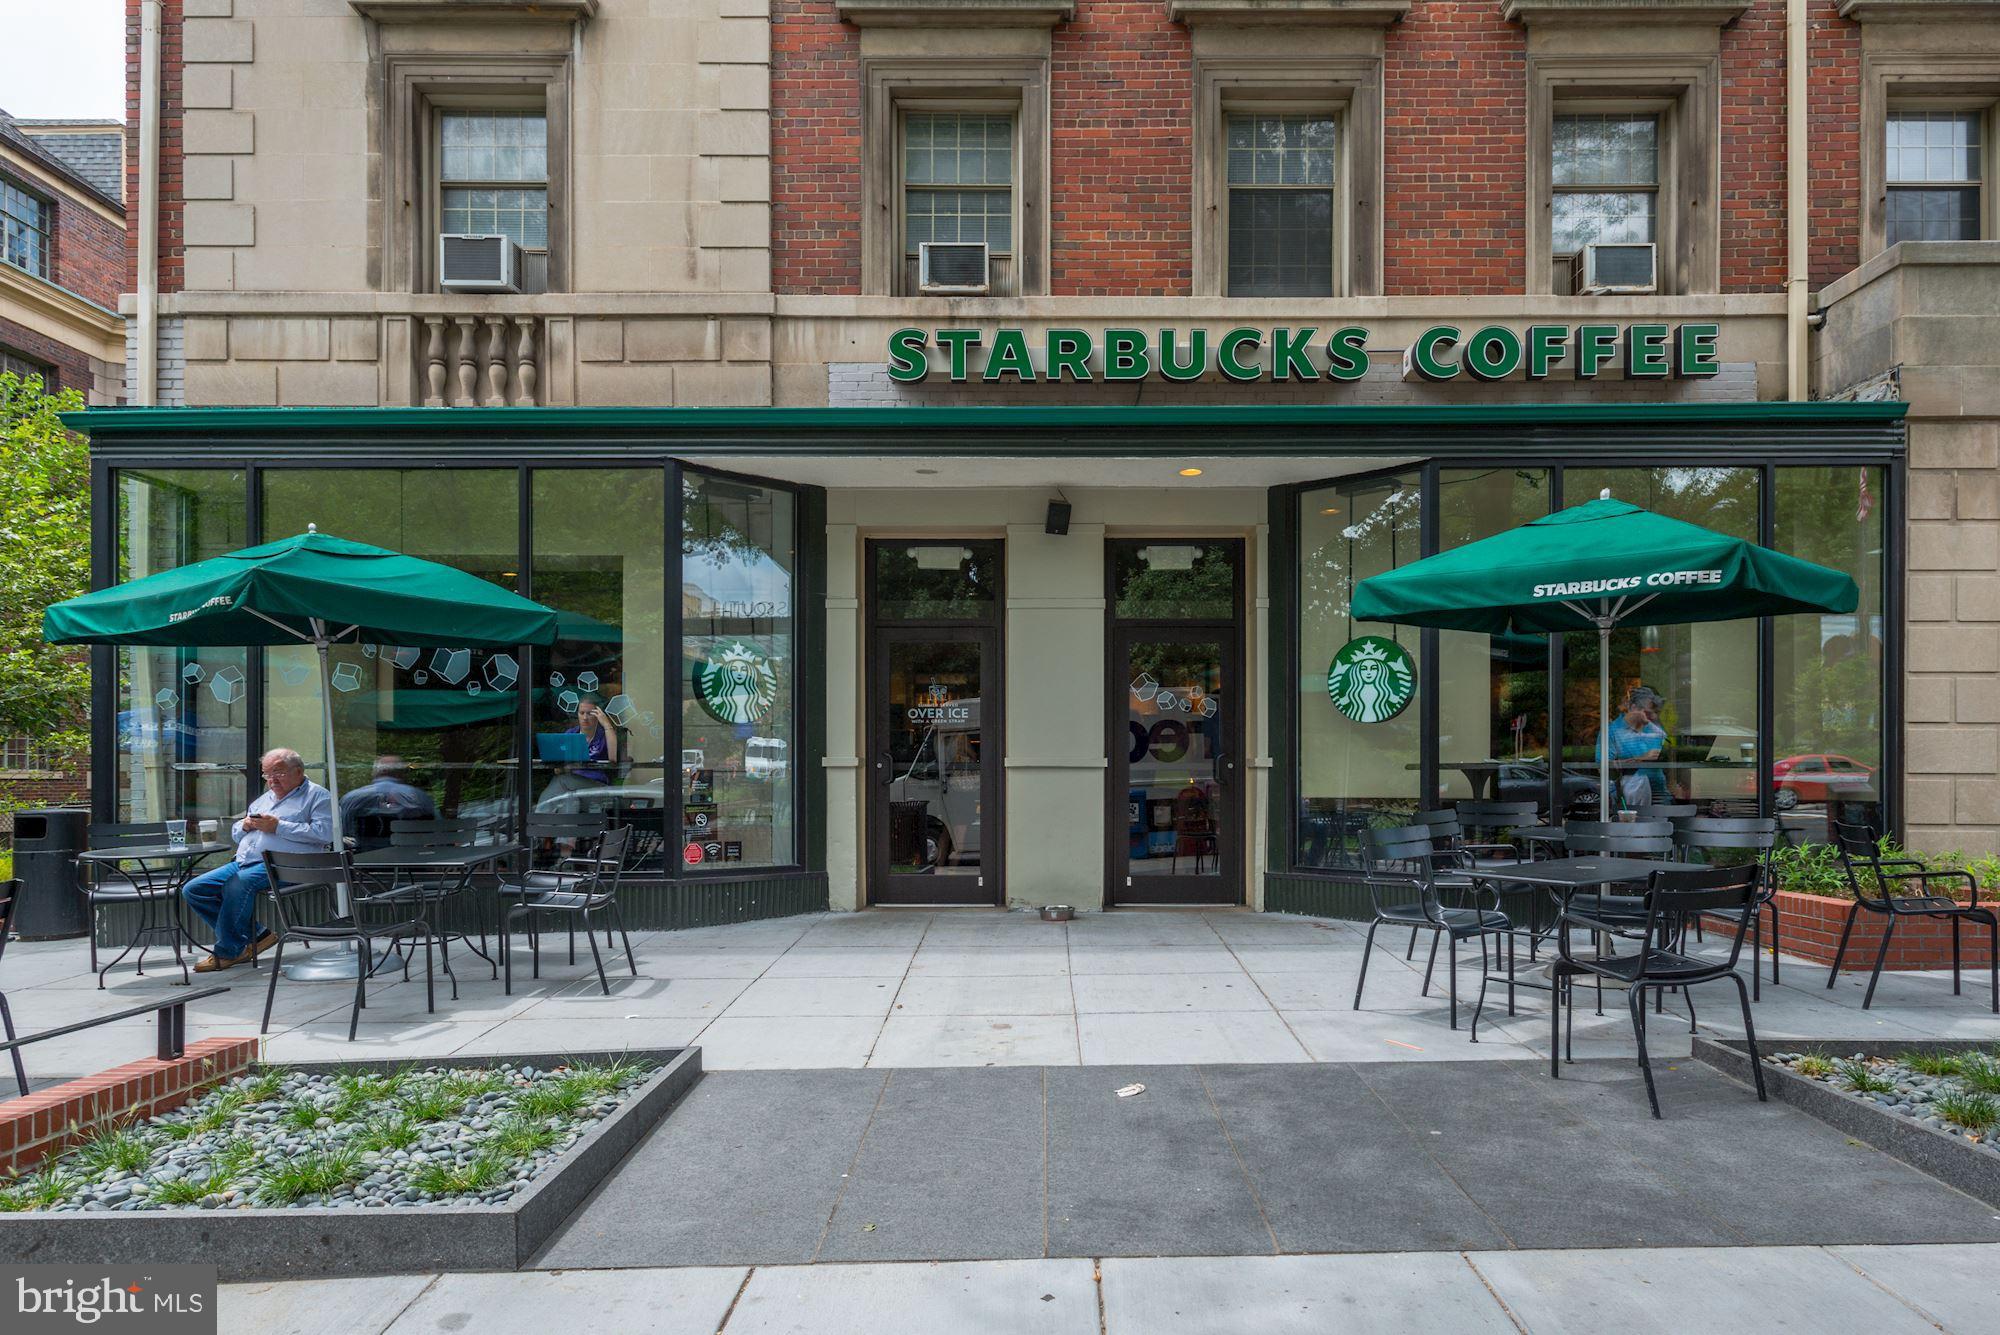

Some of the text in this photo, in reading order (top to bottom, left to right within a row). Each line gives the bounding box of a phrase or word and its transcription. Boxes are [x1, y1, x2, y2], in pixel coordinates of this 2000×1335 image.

[887, 322, 1721, 384] STARBUCKS COFFEE
[1533, 570, 1722, 597] STARBUCKS COFFEE
[907, 708, 969, 719] OVER ICE
